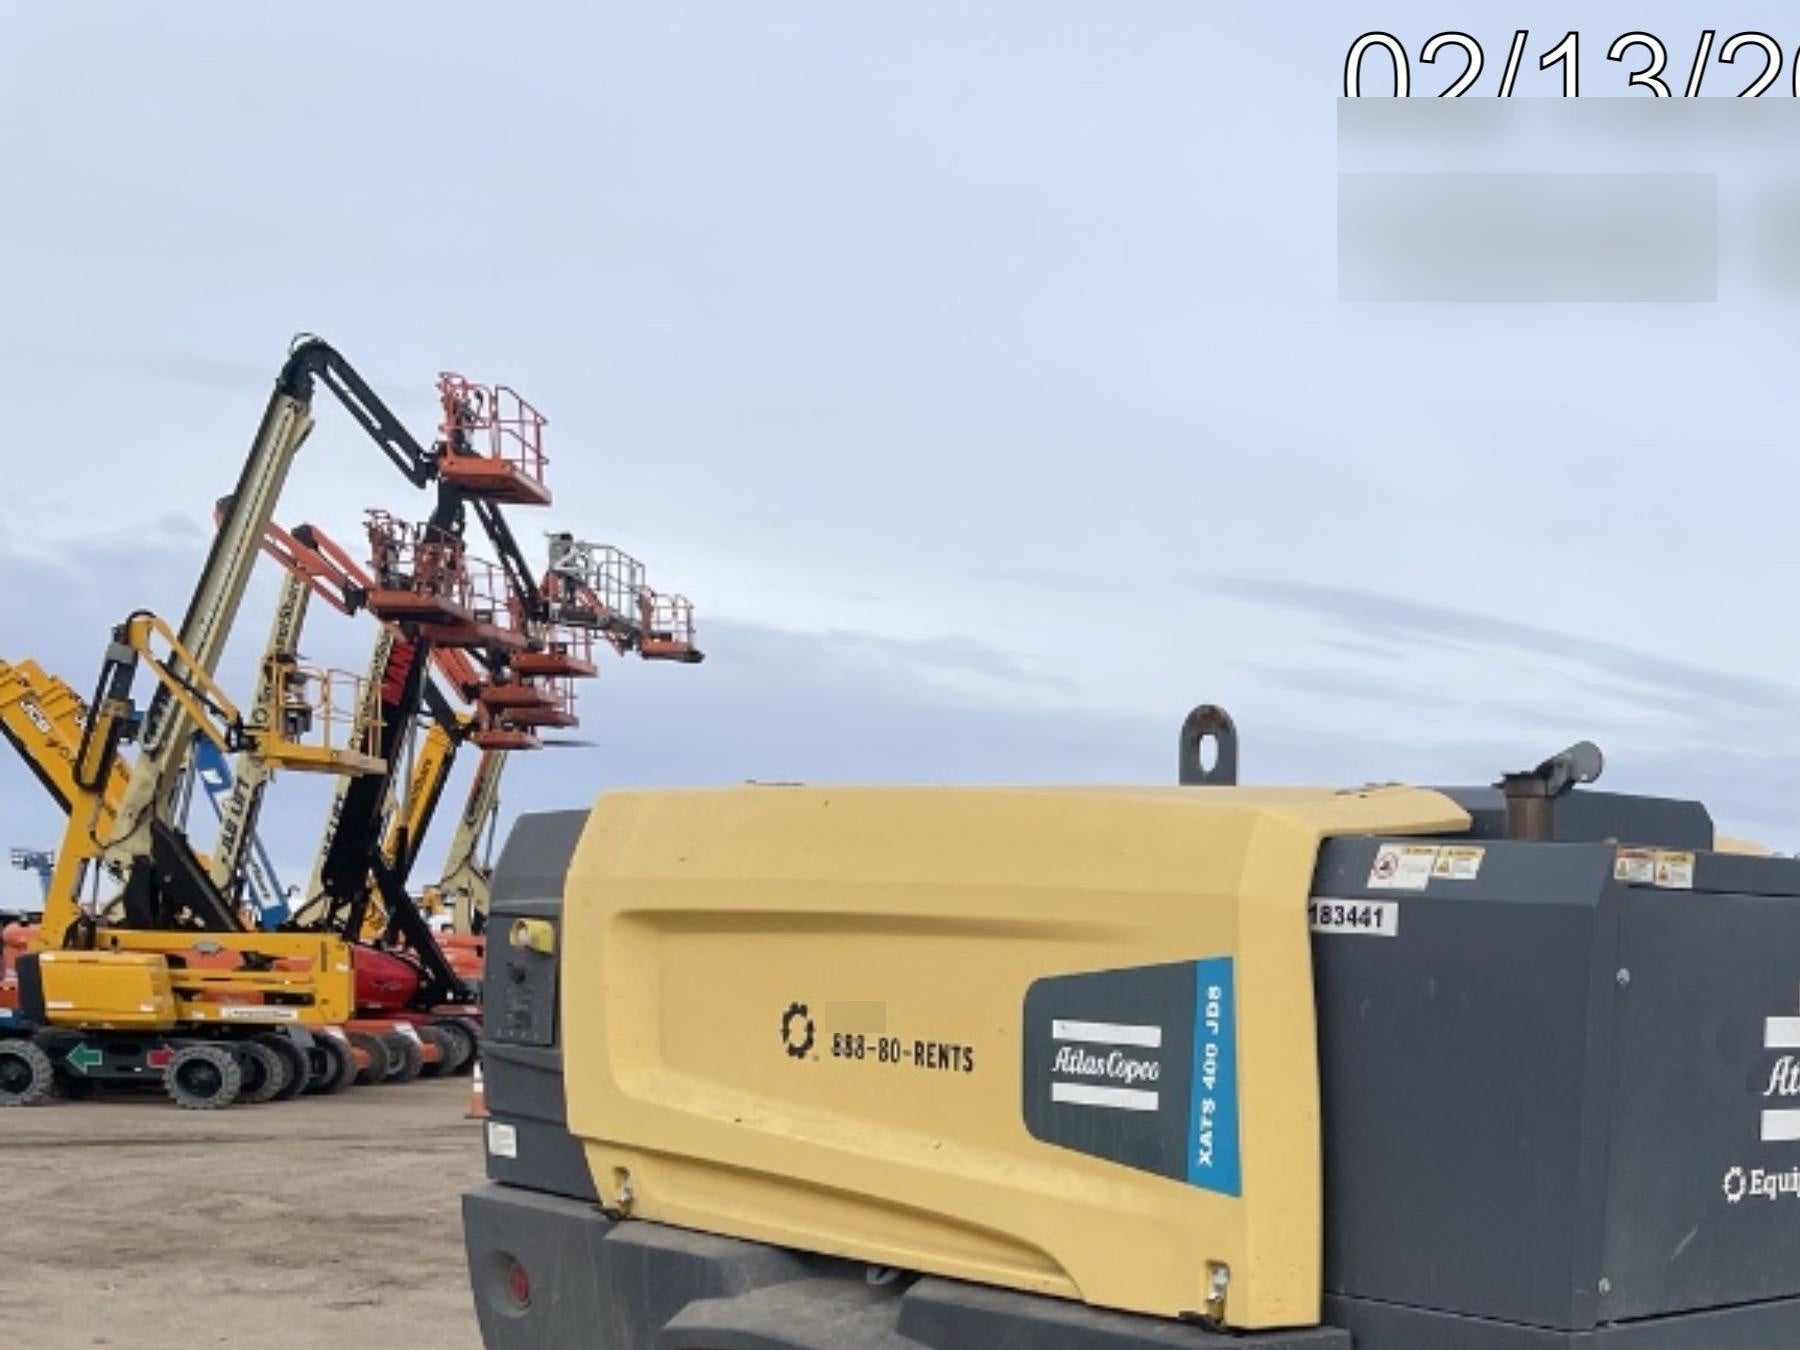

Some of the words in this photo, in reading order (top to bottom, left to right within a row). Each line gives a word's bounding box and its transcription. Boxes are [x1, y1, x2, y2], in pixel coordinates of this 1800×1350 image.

[1308, 903, 1384, 928] 183441
[1202, 1042, 1219, 1090] 400
[1198, 1097, 1215, 1168] XATS
